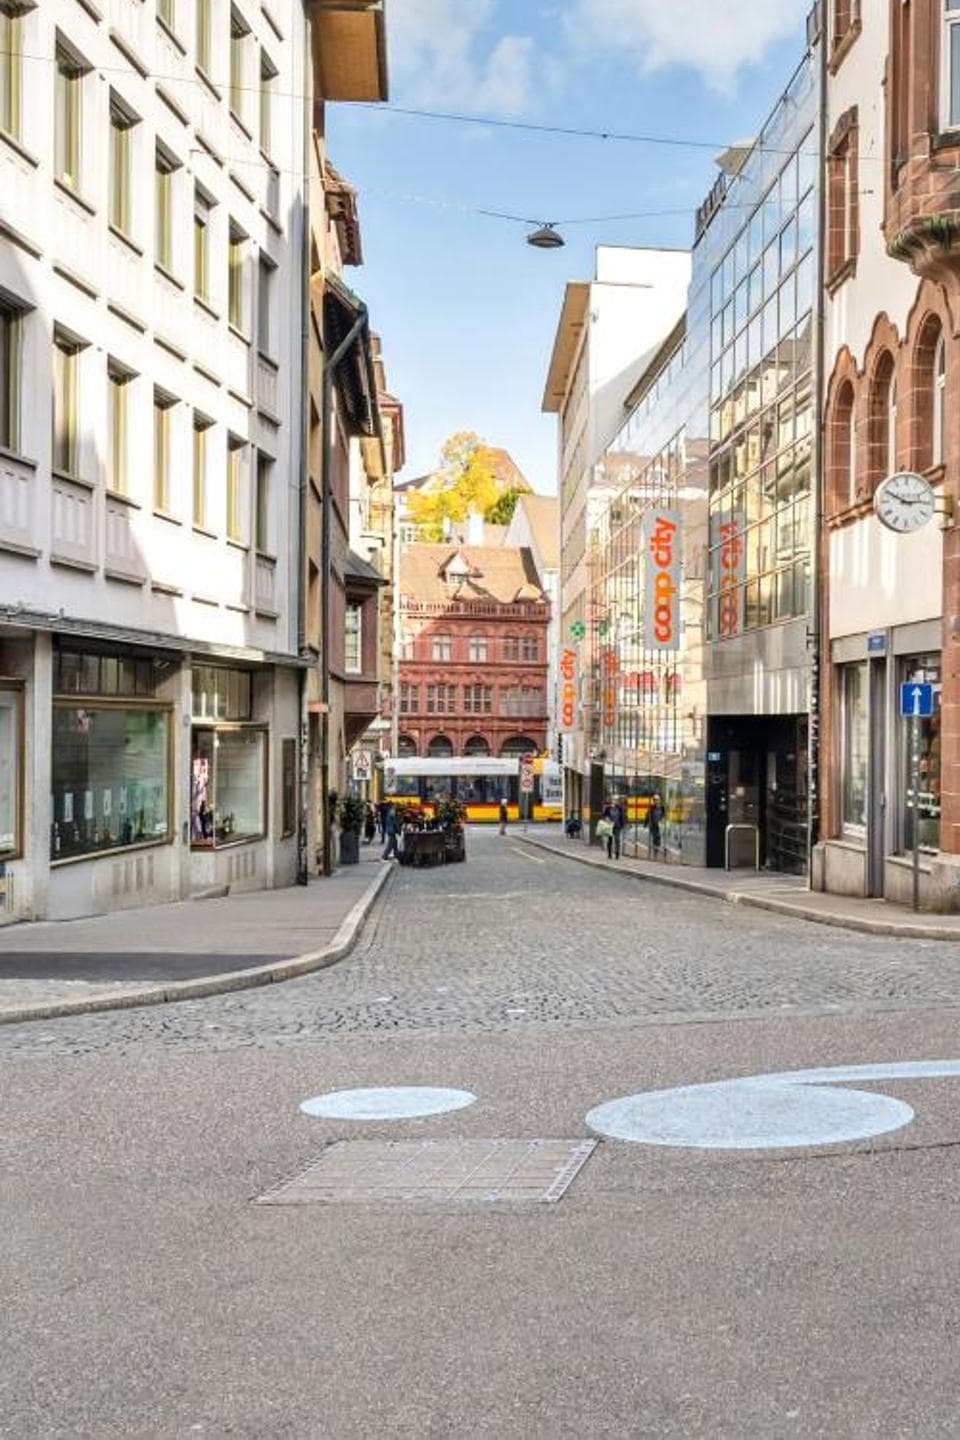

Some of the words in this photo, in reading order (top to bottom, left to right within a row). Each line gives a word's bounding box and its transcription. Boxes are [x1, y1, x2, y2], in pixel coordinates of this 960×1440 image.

[649, 516, 677, 569] city
[653, 571, 677, 643] coop
[562, 682, 577, 727] coop
